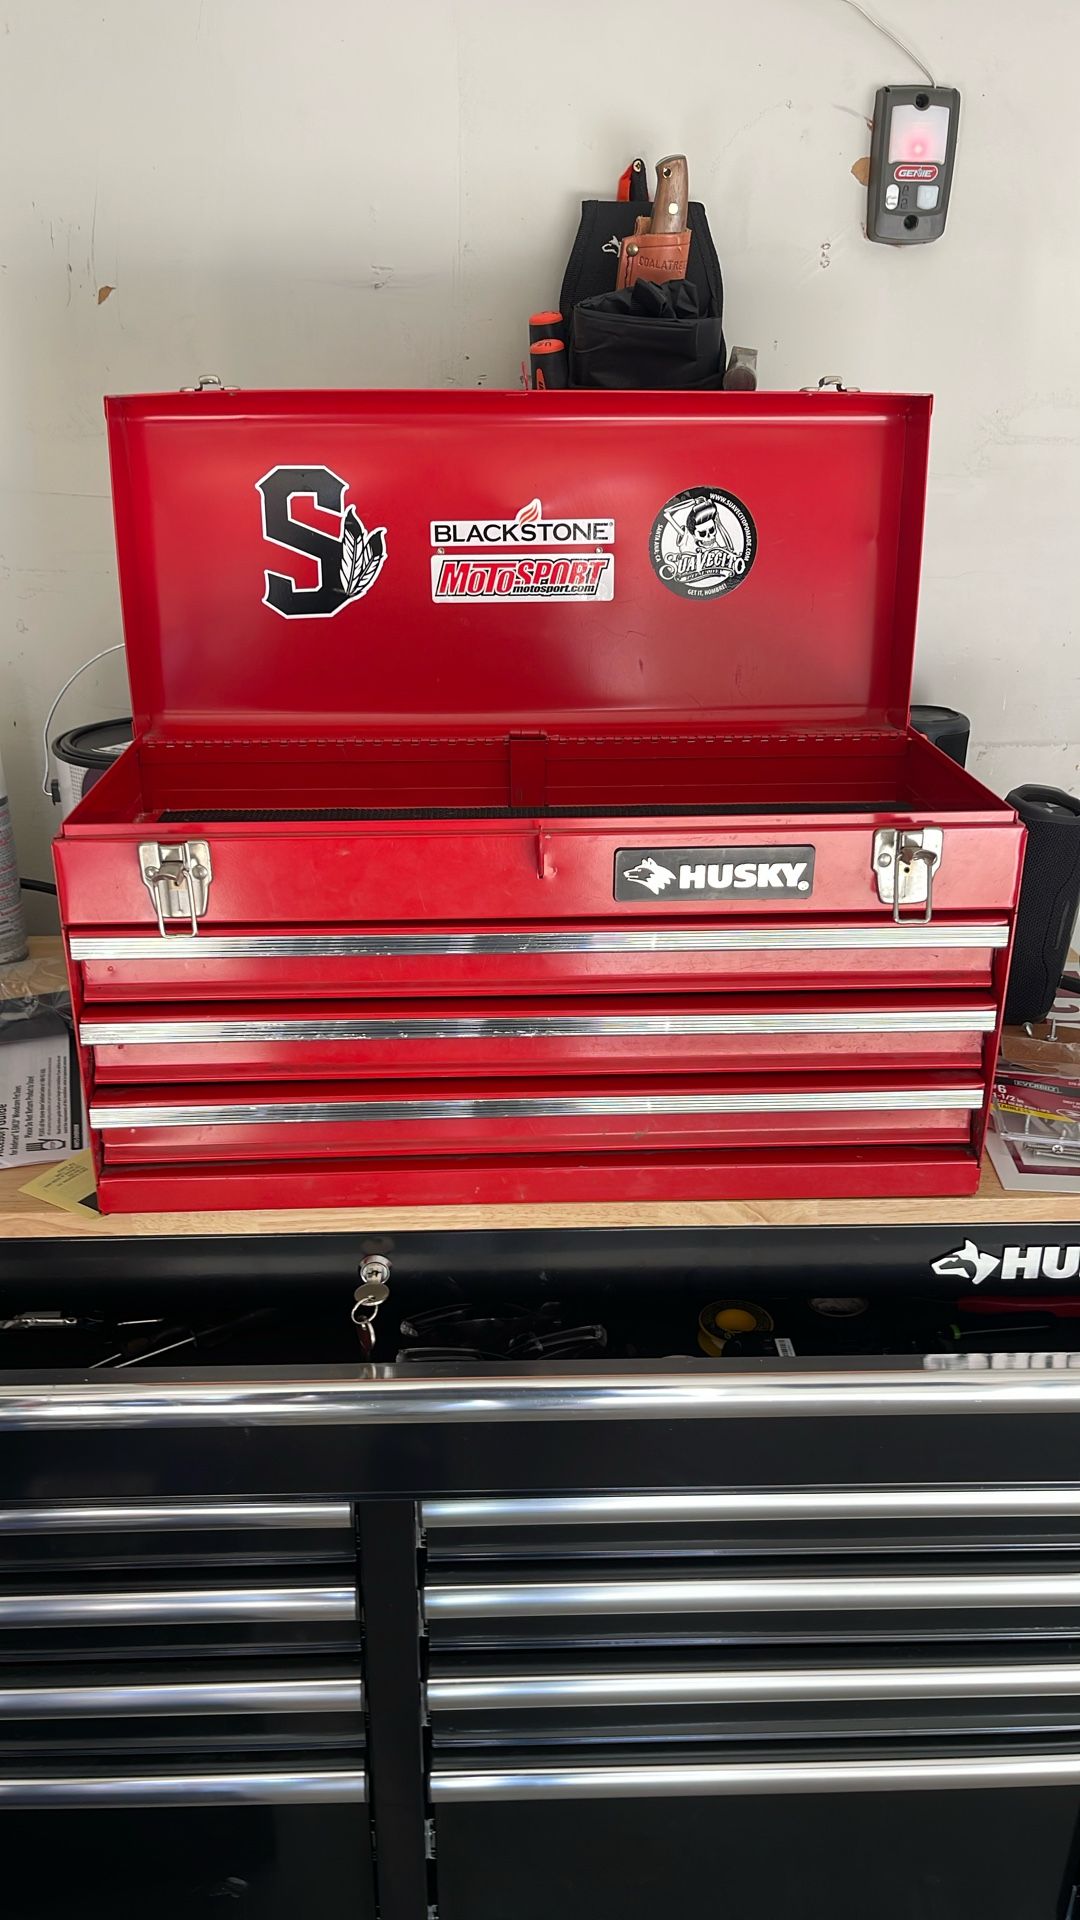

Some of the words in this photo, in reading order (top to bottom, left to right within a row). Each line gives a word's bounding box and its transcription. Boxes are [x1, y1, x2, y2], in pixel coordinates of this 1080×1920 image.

[898, 167, 935, 178] GENIE
[434, 523, 609, 543] BLACKSTONE
[512, 585, 595, 595] motosport.com
[688, 588, 696, 596] GET
[679, 863, 808, 889] HUSKY
[1000, 1246, 1080, 1280] HU
